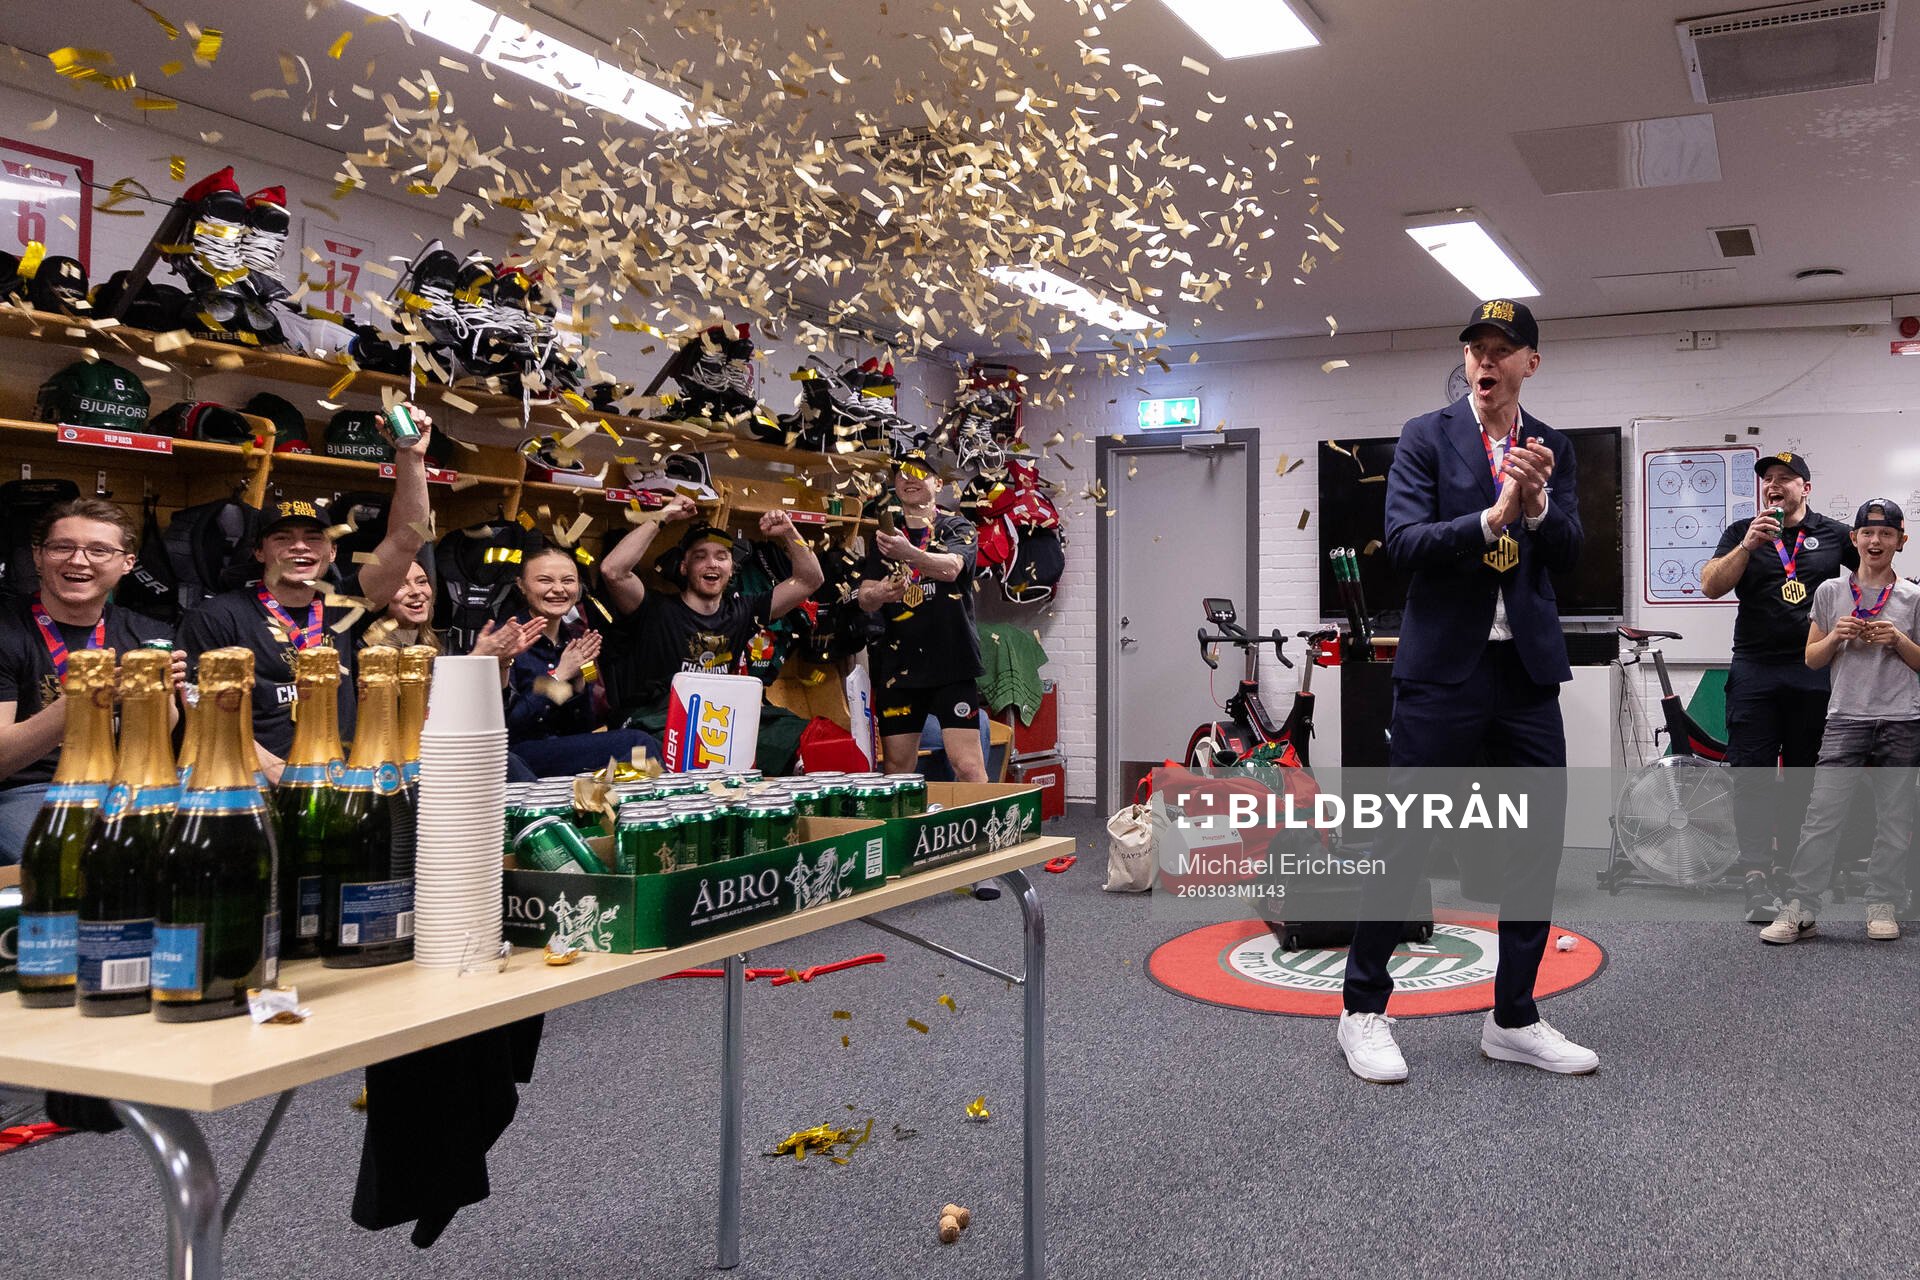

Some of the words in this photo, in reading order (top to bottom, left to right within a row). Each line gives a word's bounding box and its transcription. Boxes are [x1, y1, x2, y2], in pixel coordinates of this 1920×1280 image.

[327, 260, 360, 314] 17
[114, 378, 126, 391] 6
[80, 399, 148, 419] BJURFORS
[347, 421, 361, 432] 17
[327, 444, 384, 456] BJURFORS
[1784, 582, 1804, 601] CHL
[665, 729, 679, 773] UER
[913, 818, 977, 857] ÅBRO
[690, 869, 779, 916] ÅBRO
[1254, 967, 1344, 989] HOCKEY
[1399, 967, 1495, 990] FRÖLUN
